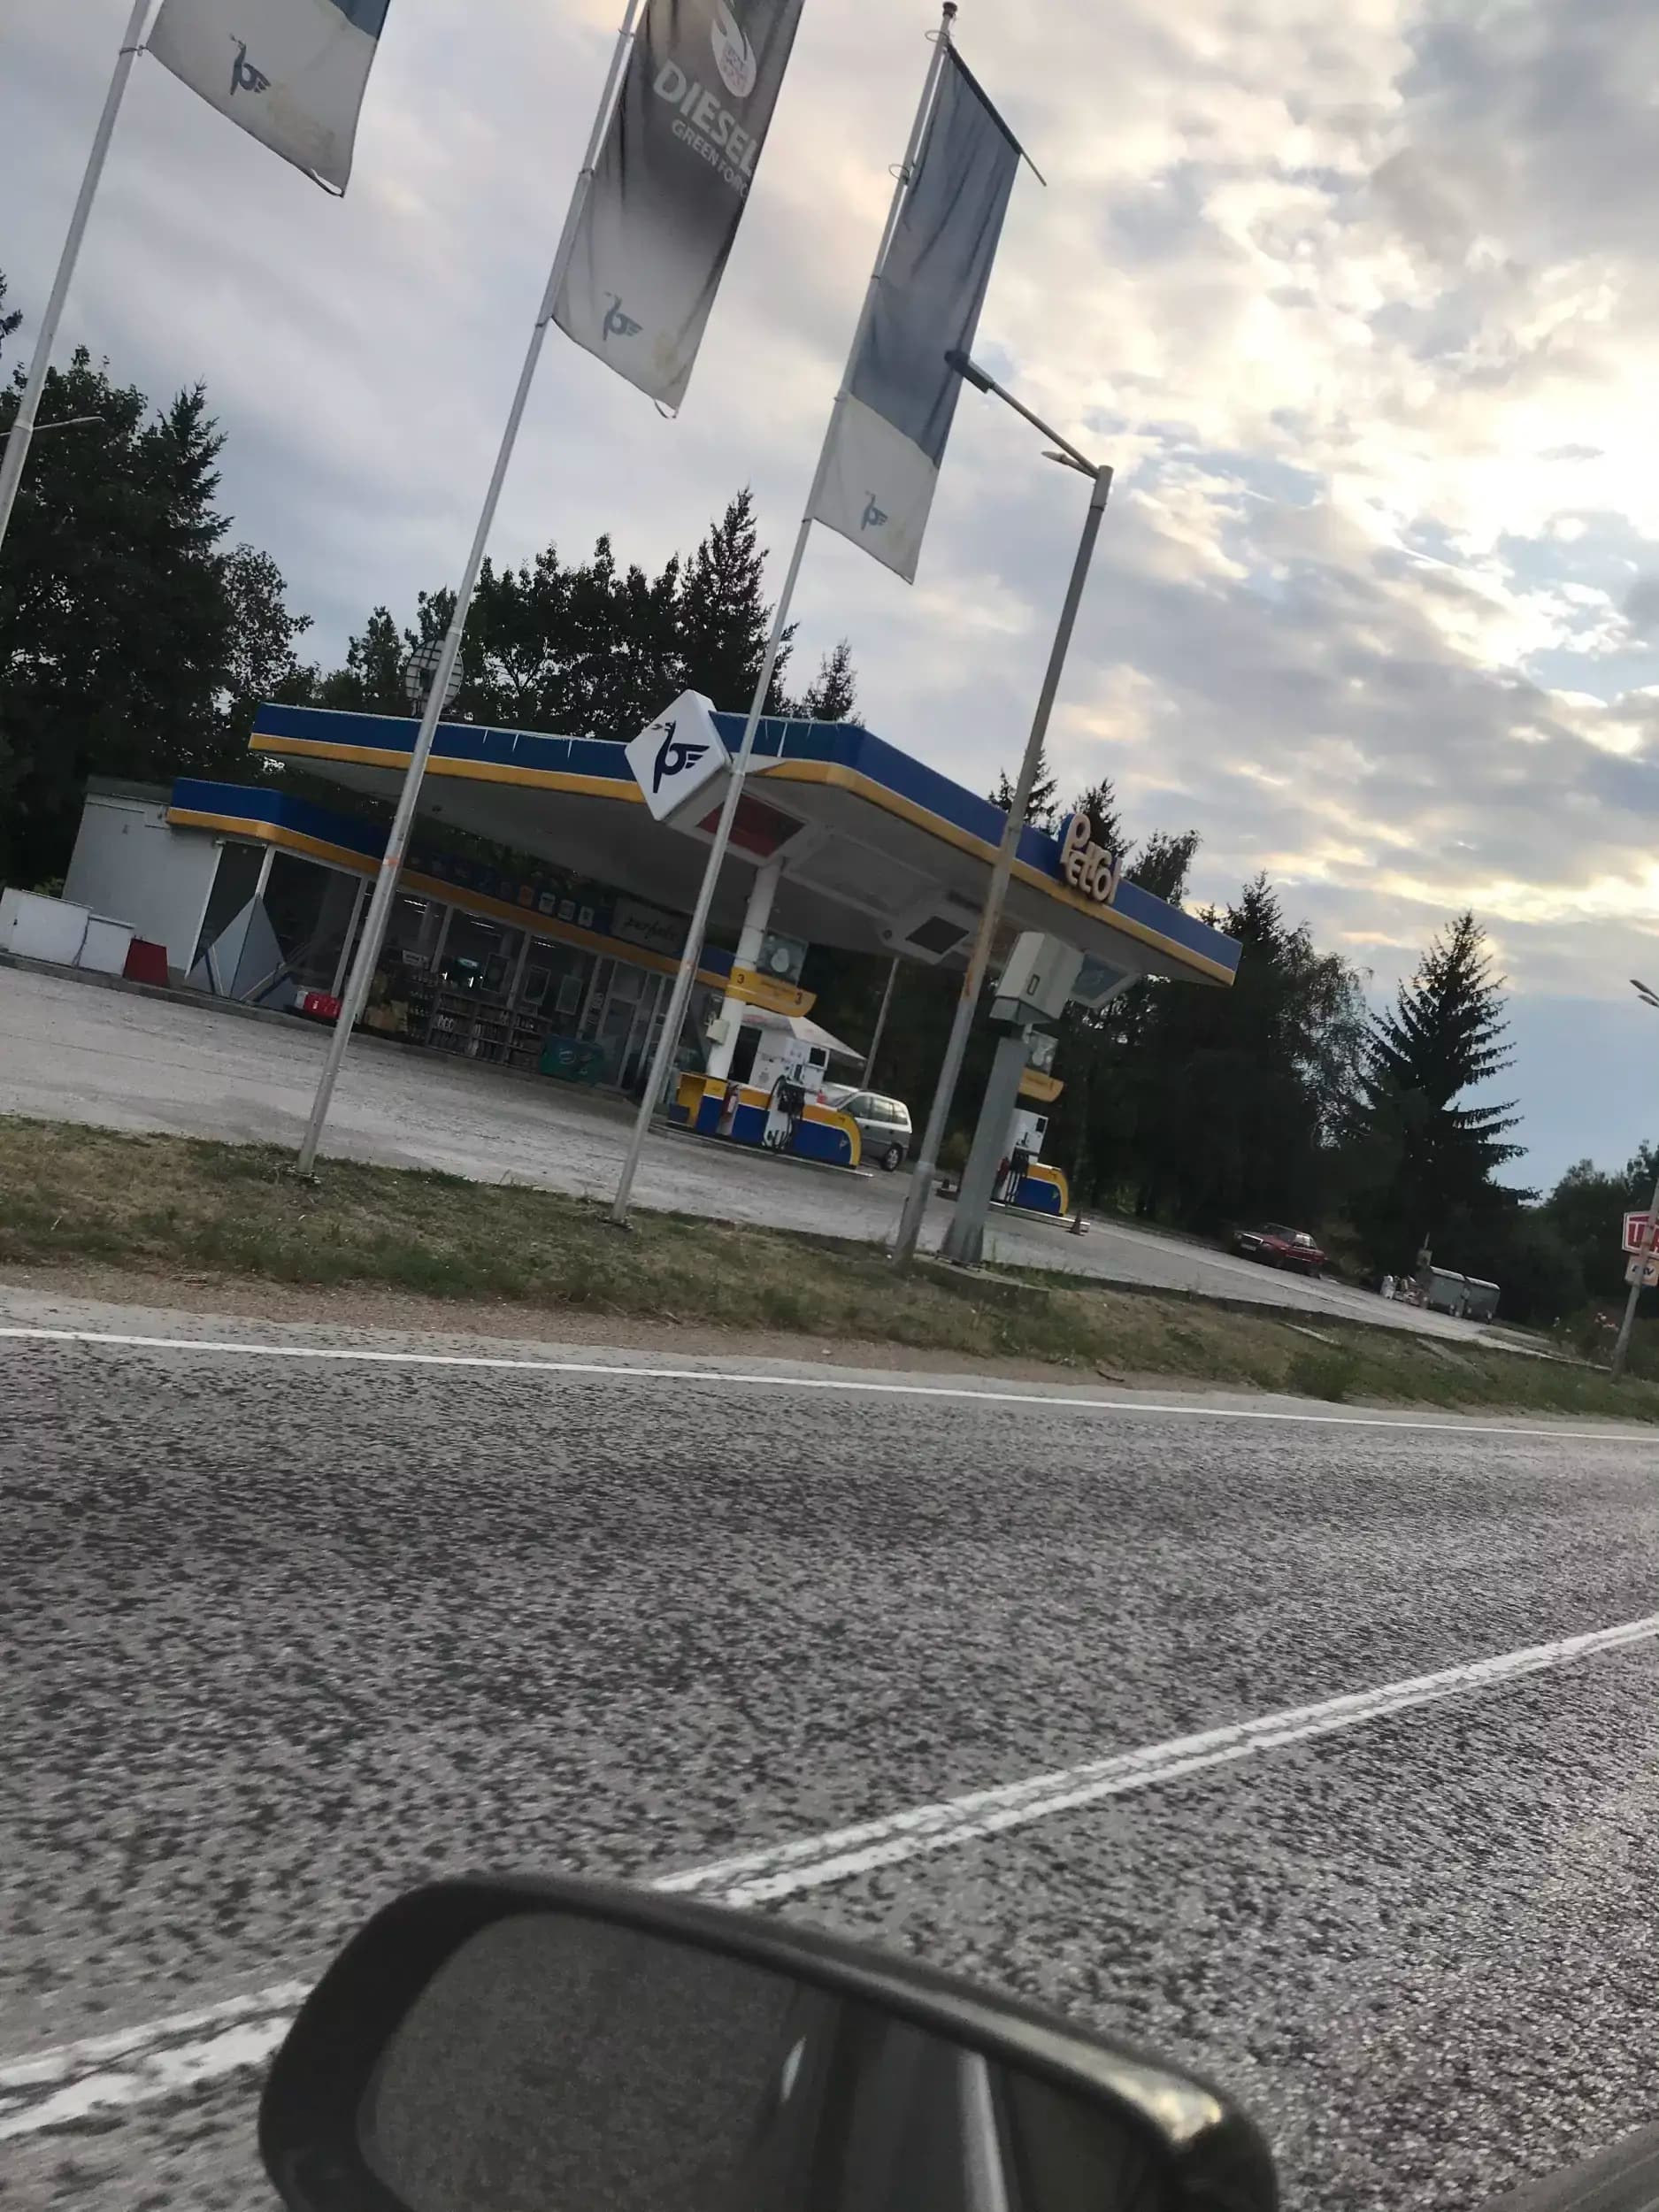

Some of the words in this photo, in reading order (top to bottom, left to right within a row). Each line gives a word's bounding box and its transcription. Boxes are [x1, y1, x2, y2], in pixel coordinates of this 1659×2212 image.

[653, 59, 757, 178] DIESEL
[672, 119, 720, 166] GREEN
[1059, 813, 1123, 904] Petrol
[736, 973, 745, 984] 3
